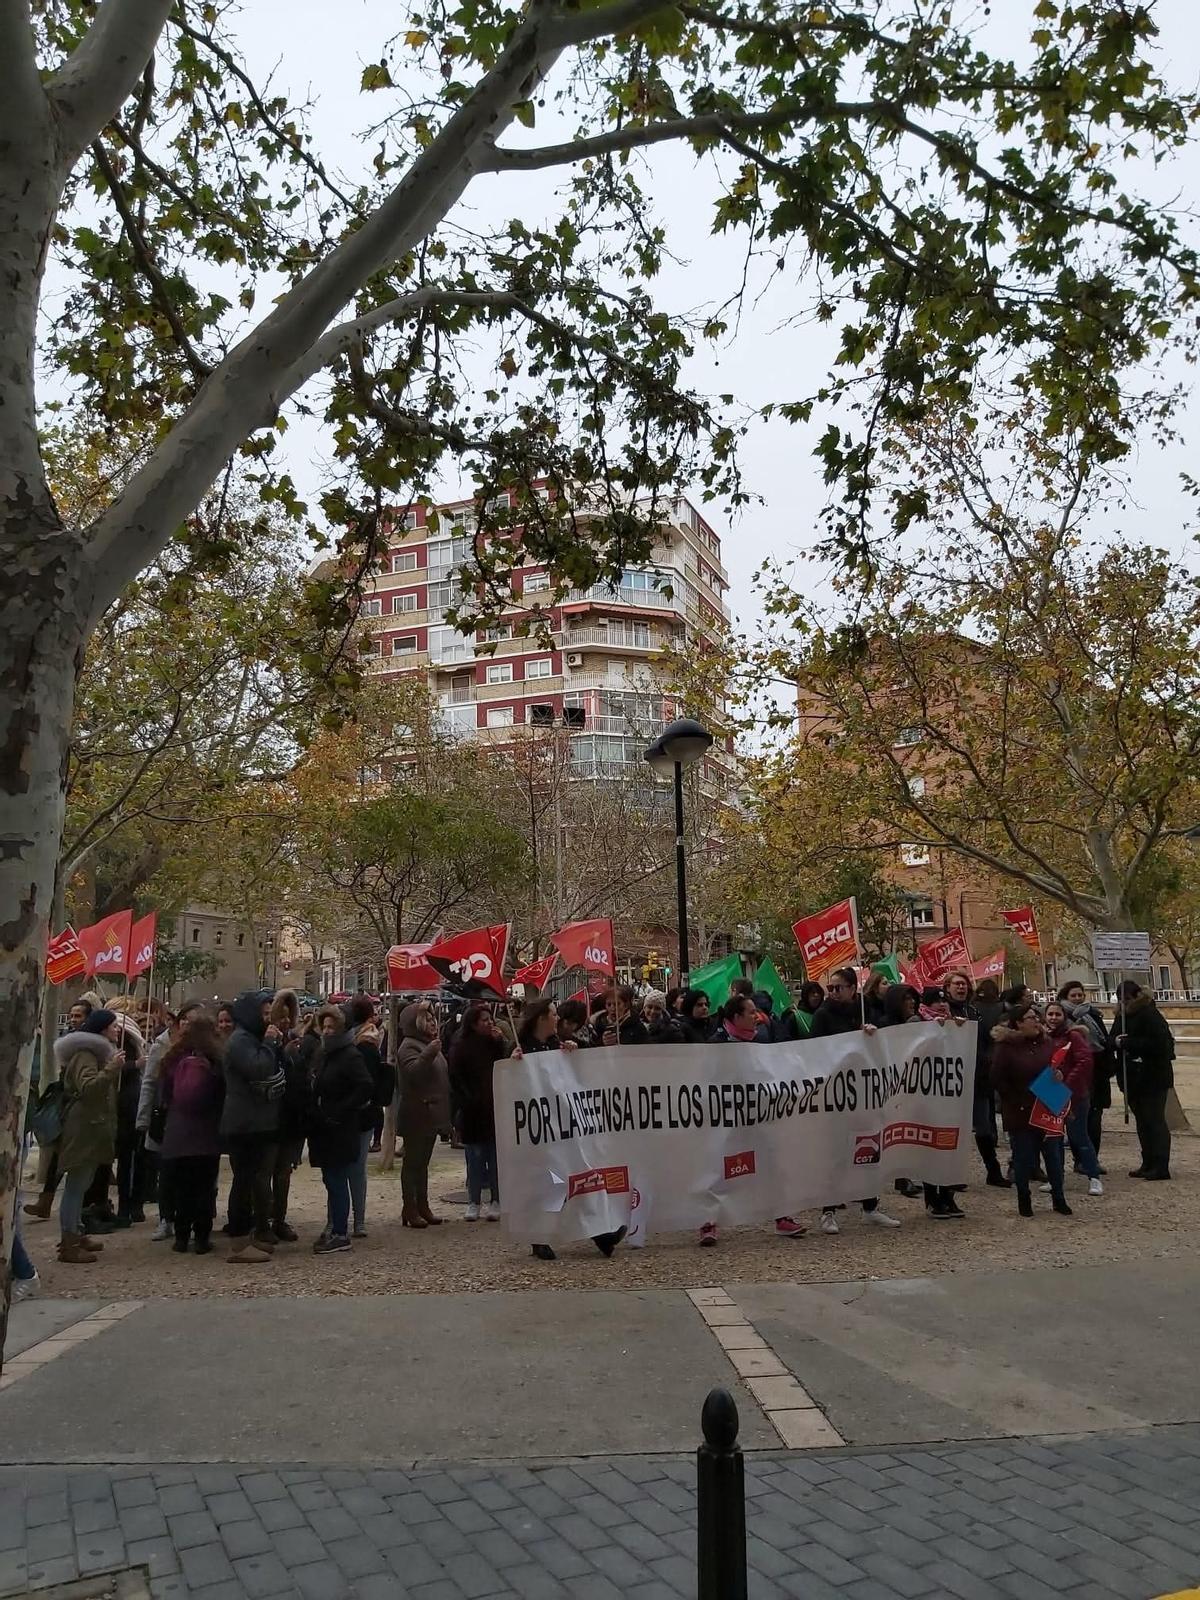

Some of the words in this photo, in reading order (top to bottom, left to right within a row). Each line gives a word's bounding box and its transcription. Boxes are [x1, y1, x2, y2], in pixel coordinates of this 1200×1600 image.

[514, 1096, 556, 1145] POR
[555, 1094, 582, 1140] LA
[638, 1085, 663, 1130] DE
[667, 1083, 704, 1129] LOS
[708, 1079, 799, 1128] DERECHOS
[798, 1076, 824, 1115] DE
[823, 1069, 858, 1113] LOS
[861, 1056, 964, 1111] TRAAADORES
[884, 1126, 933, 1145] CCOO
[855, 1155, 874, 1164] CGT
[730, 1163, 749, 1176] SOA
